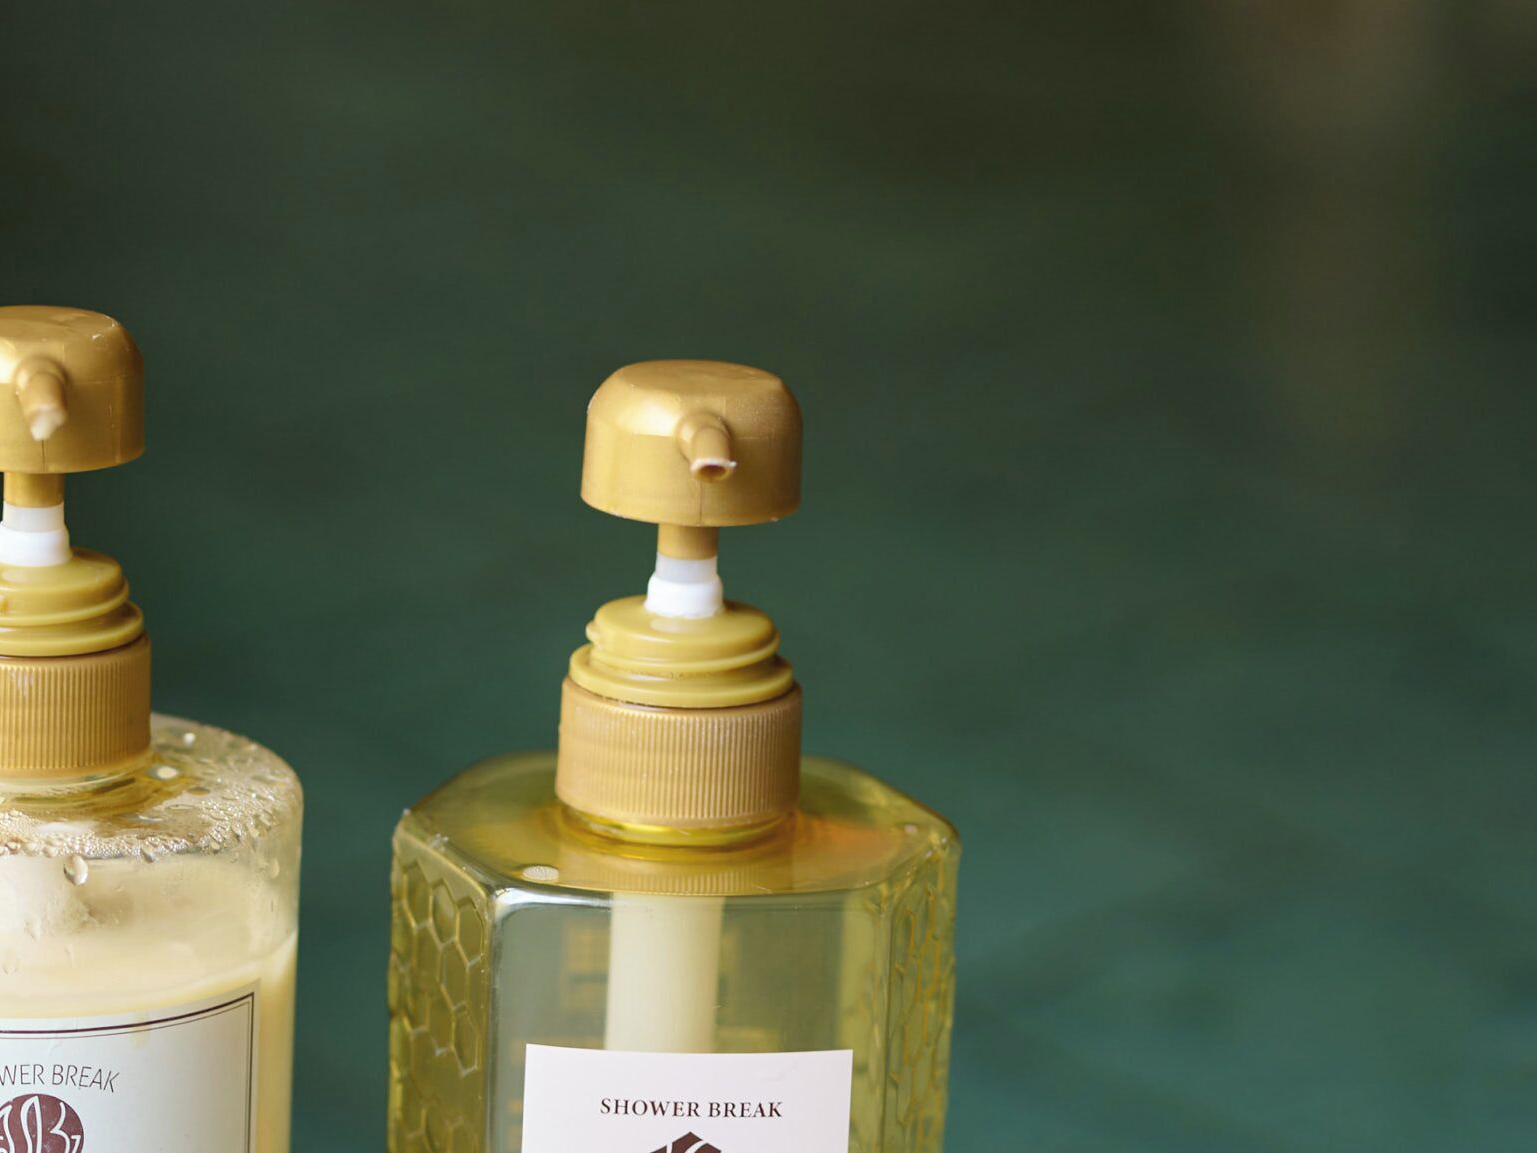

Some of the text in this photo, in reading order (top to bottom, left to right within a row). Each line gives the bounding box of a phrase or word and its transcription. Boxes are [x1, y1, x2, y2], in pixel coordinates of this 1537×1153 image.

[53, 1065, 120, 1093] BREAK
[601, 1098, 783, 1118] SHOWER BREAK
